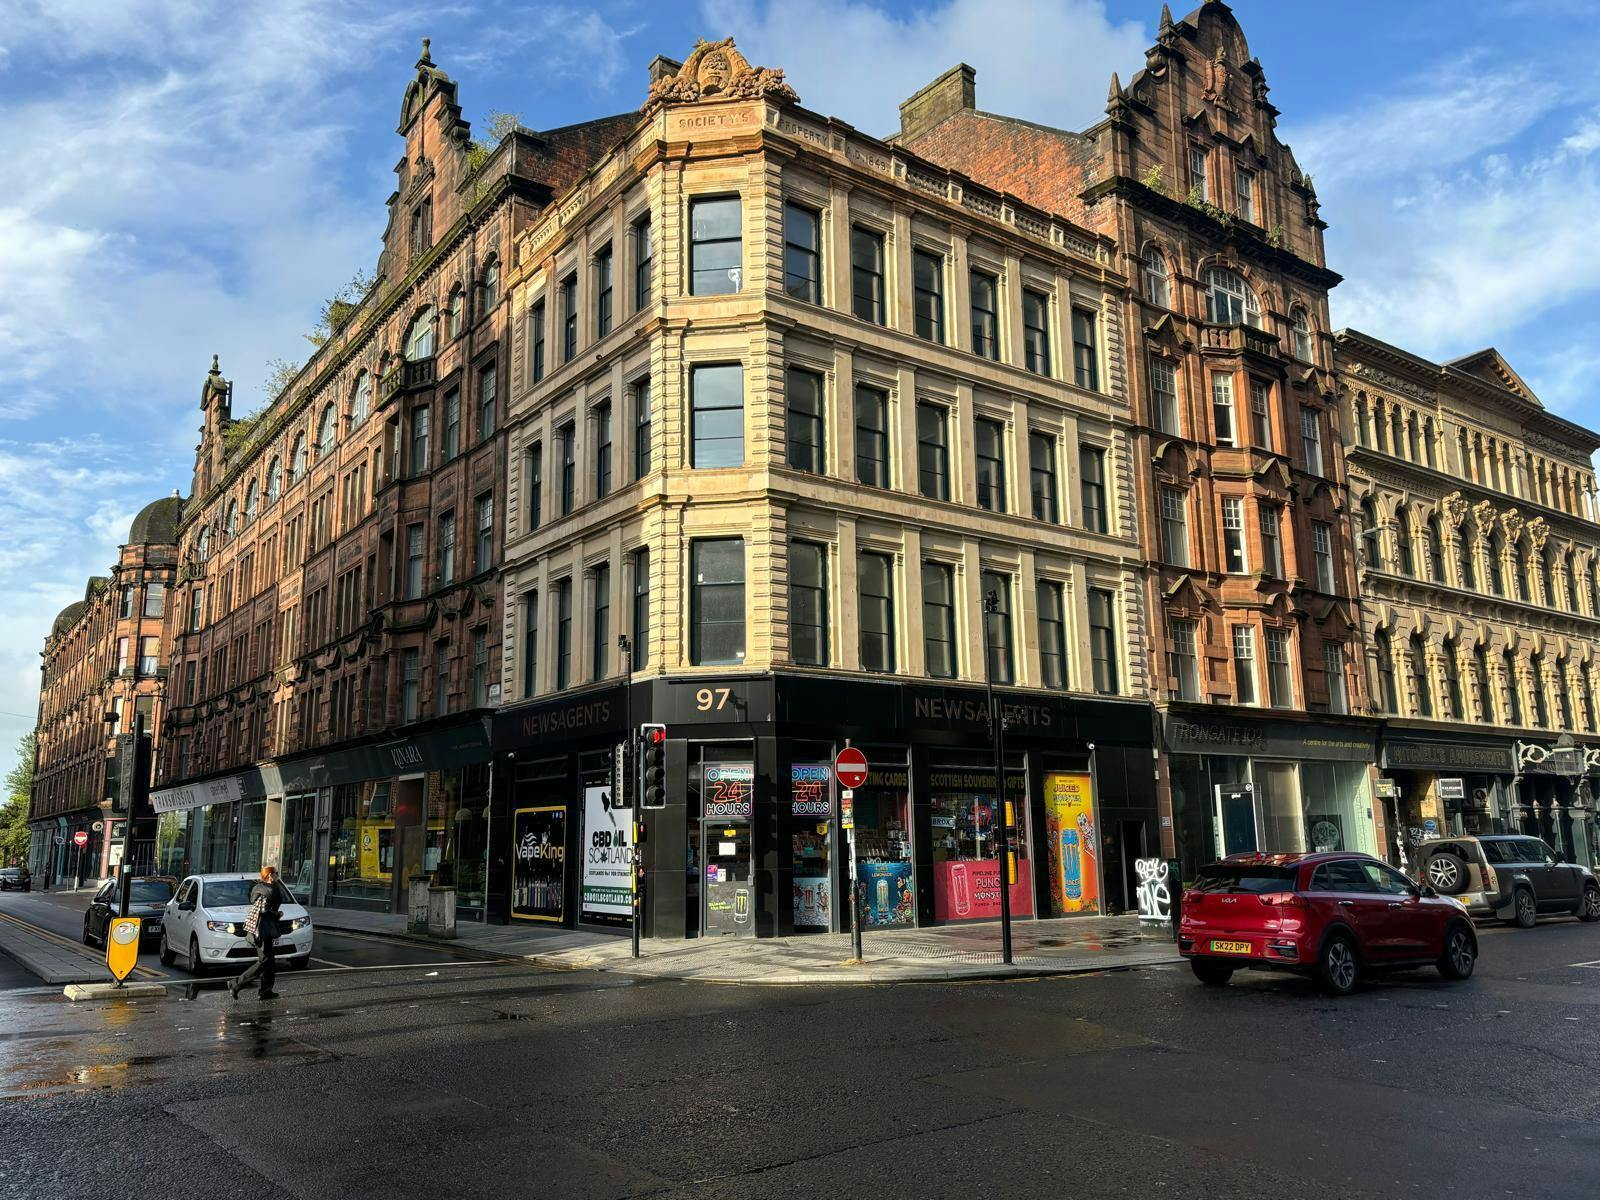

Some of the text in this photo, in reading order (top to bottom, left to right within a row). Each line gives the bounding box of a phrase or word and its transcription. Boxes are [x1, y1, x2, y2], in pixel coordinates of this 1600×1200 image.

[678, 113, 749, 128] SOCIETY'S
[779, 118, 828, 147] PROPERTY
[696, 688, 731, 711] 97
[522, 700, 610, 736] NEWSAGENTS
[914, 696, 1052, 727] NEWSAENTS
[708, 768, 750, 781] OPEN
[791, 768, 829, 781] OPEN
[884, 771, 908, 788] CARDS
[930, 772, 962, 788] SCOTTISH
[963, 774, 997, 789] SOUVENIR
[1006, 775, 1025, 790] GIFTS
[155, 789, 195, 809] TRANSMISSION
[713, 781, 742, 802] 24
[795, 781, 823, 802] 24
[706, 803, 750, 815] HOURS
[592, 830, 612, 848] CBD
[515, 838, 565, 863] VapeKing
[976, 877, 1001, 889] PUNC
[974, 891, 1001, 900] MONST
[1215, 942, 1250, 951] SK22 DPY
